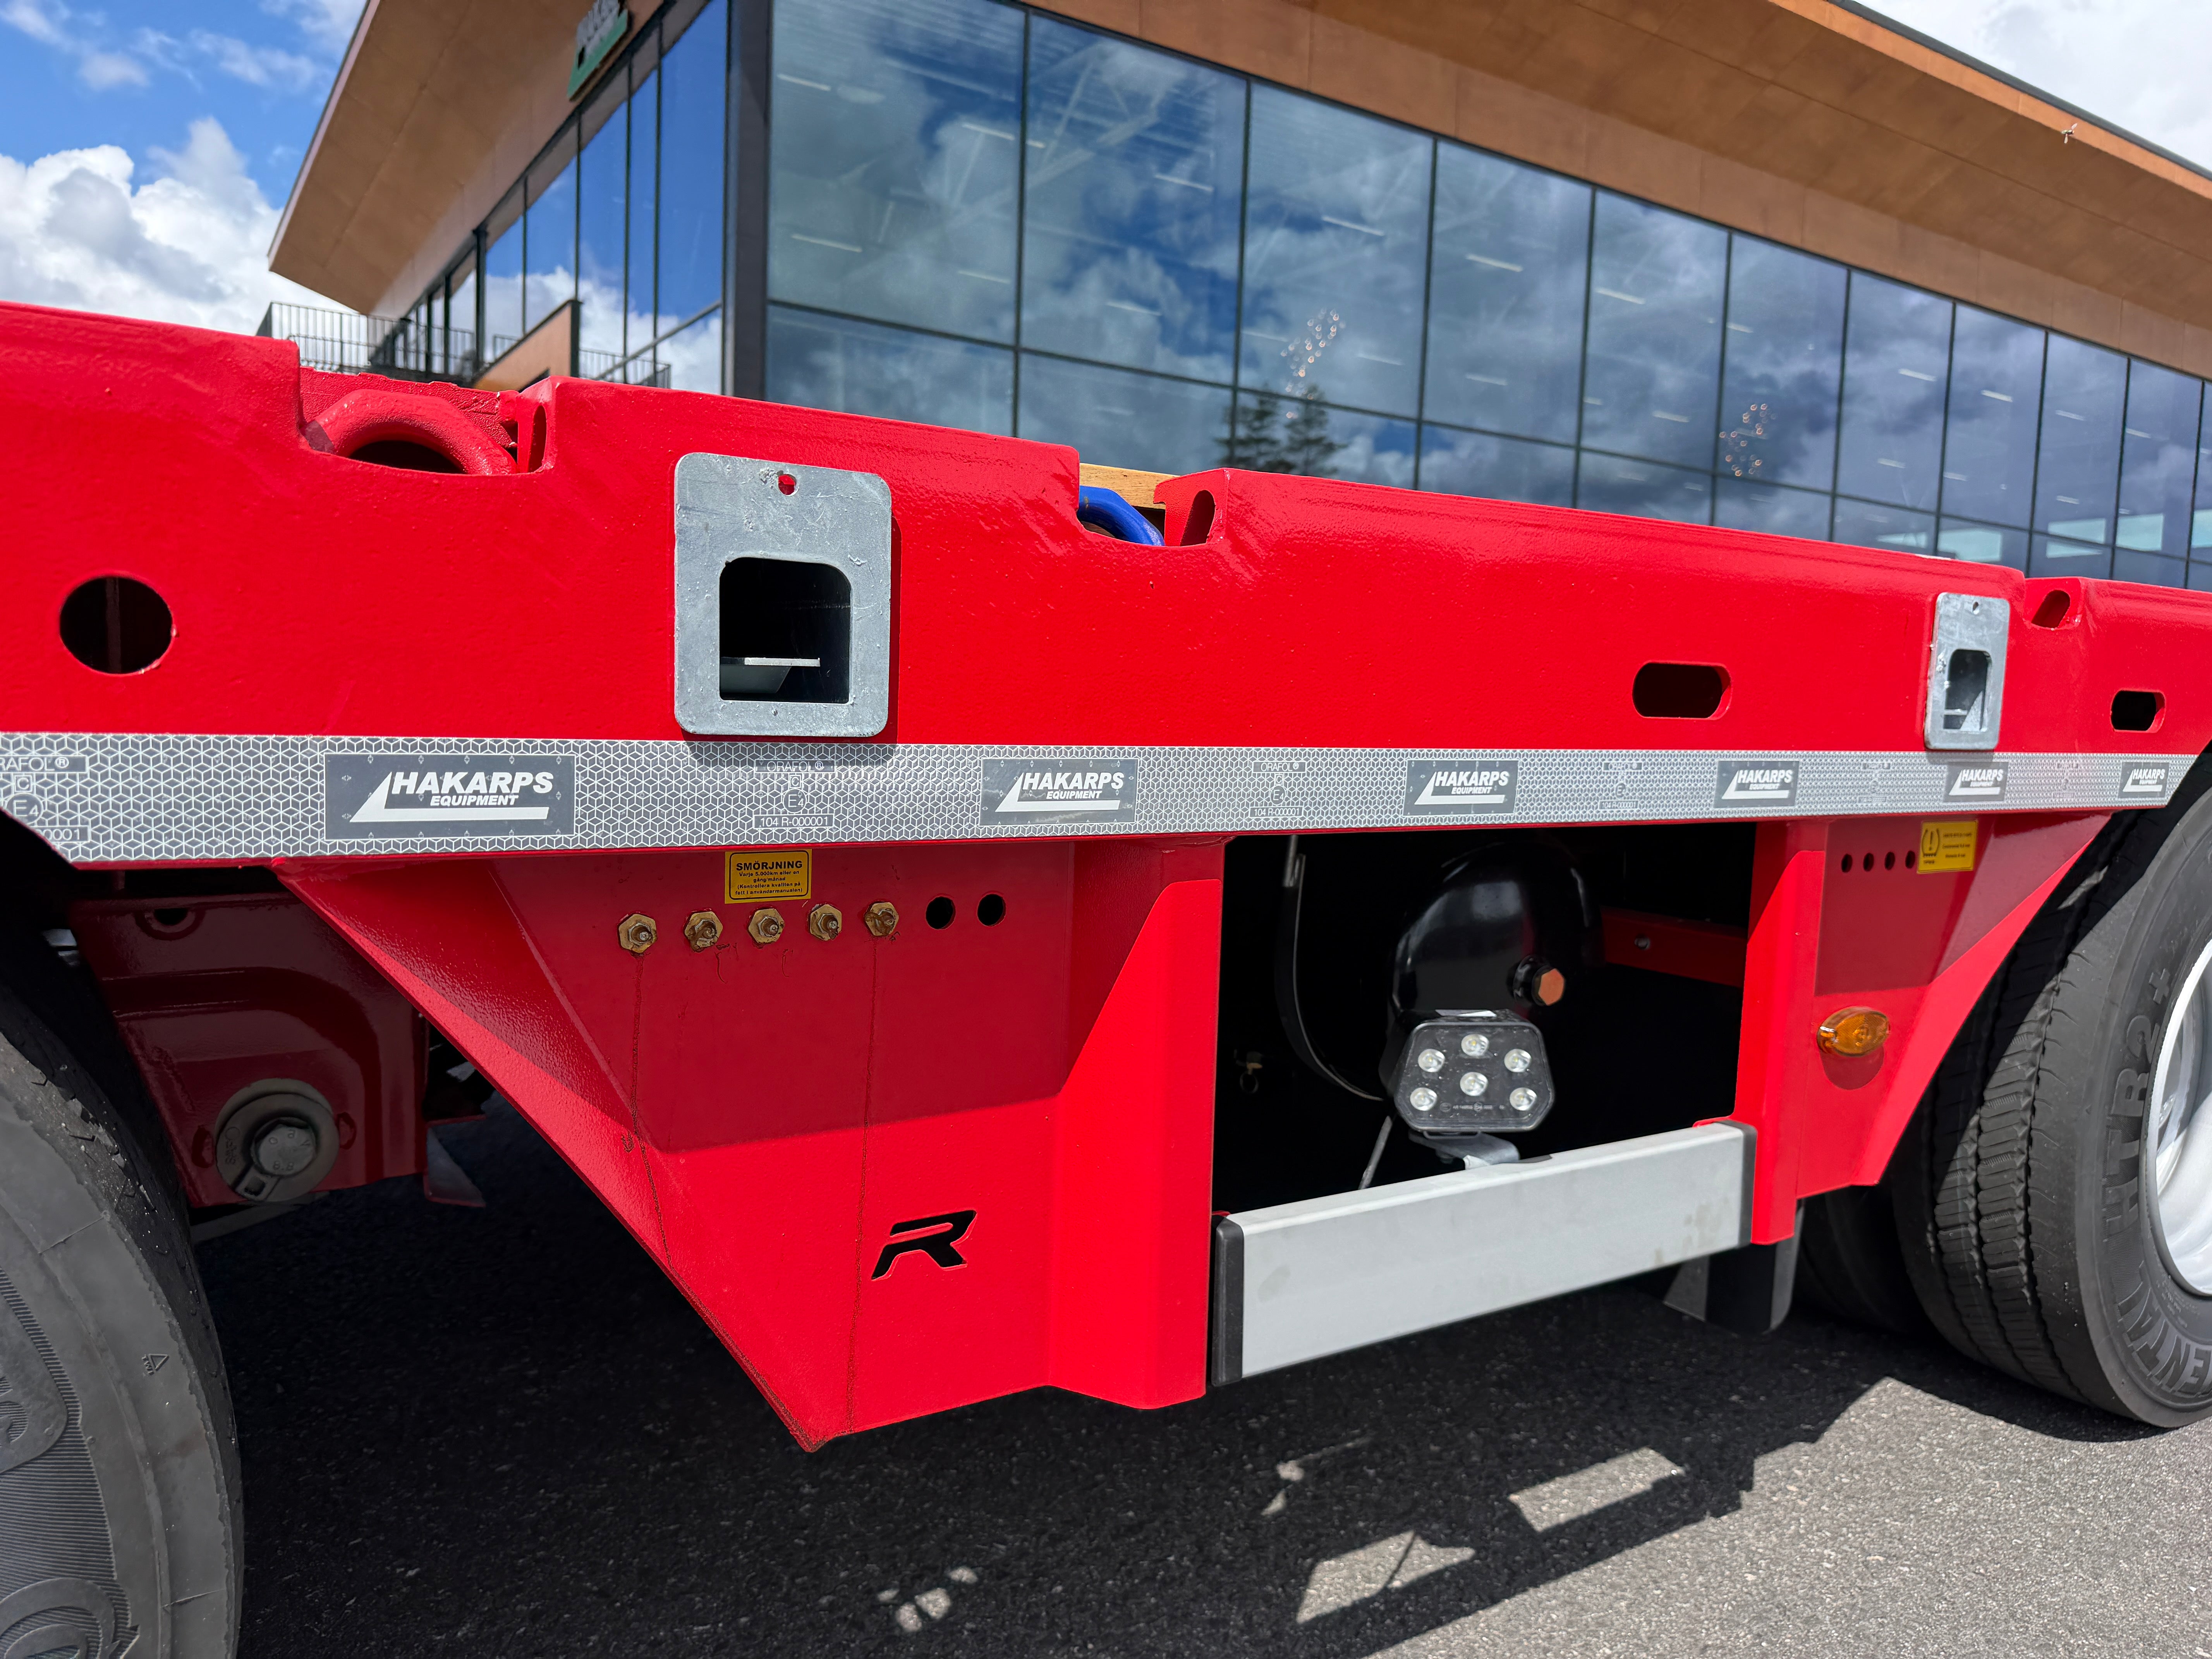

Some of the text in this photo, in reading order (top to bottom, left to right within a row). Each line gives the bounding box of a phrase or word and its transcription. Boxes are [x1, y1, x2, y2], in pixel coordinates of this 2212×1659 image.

[1435, 771, 1510, 787] HAKARPS
[1737, 769, 1793, 783] HAKARPS
[1961, 769, 2004, 781] HAKARPS
[2133, 768, 2166, 780] HAKARPS
[391, 772, 553, 795] HAKARPS
[1022, 772, 1124, 790] HAKARPS
[1046, 790, 1102, 799] EQUIPMENT
[1451, 787, 1492, 795] EQUIPMENT
[430, 795, 518, 807] EQUIPMENT
[1268, 808, 1299, 816] R-000001
[761, 816, 828, 827] 104 R-000001
[736, 860, 803, 871] SMÖRJNING
